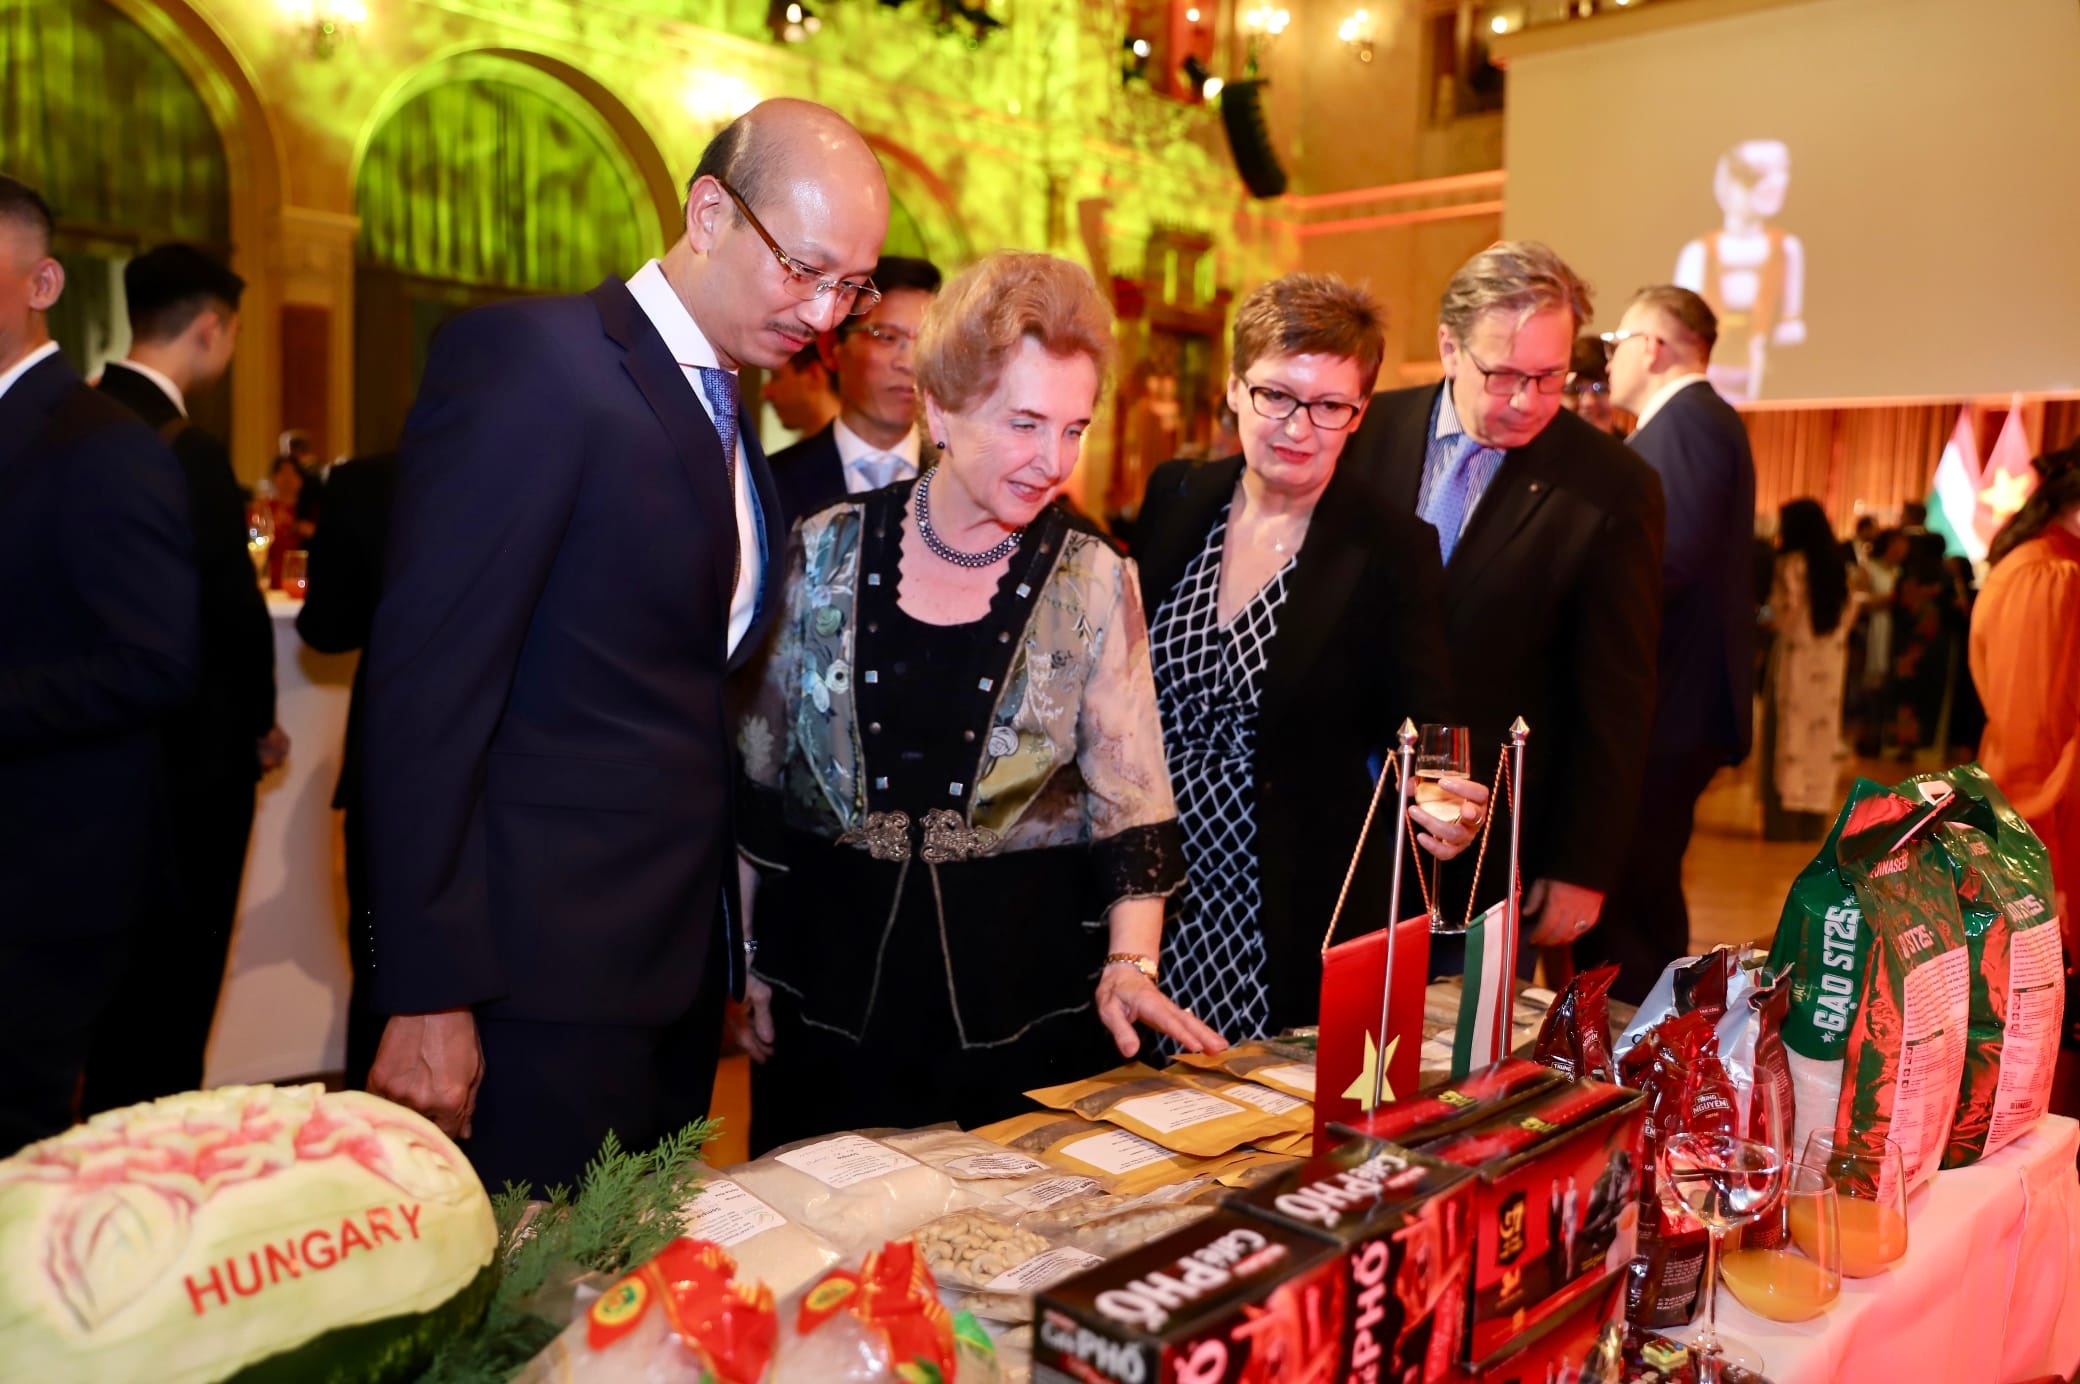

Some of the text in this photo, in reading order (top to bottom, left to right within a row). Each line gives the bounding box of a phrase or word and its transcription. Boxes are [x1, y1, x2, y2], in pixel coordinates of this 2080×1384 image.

[1813, 905, 1861, 1032] GẠO ST25
[184, 1203, 421, 1317] HUNGARY
